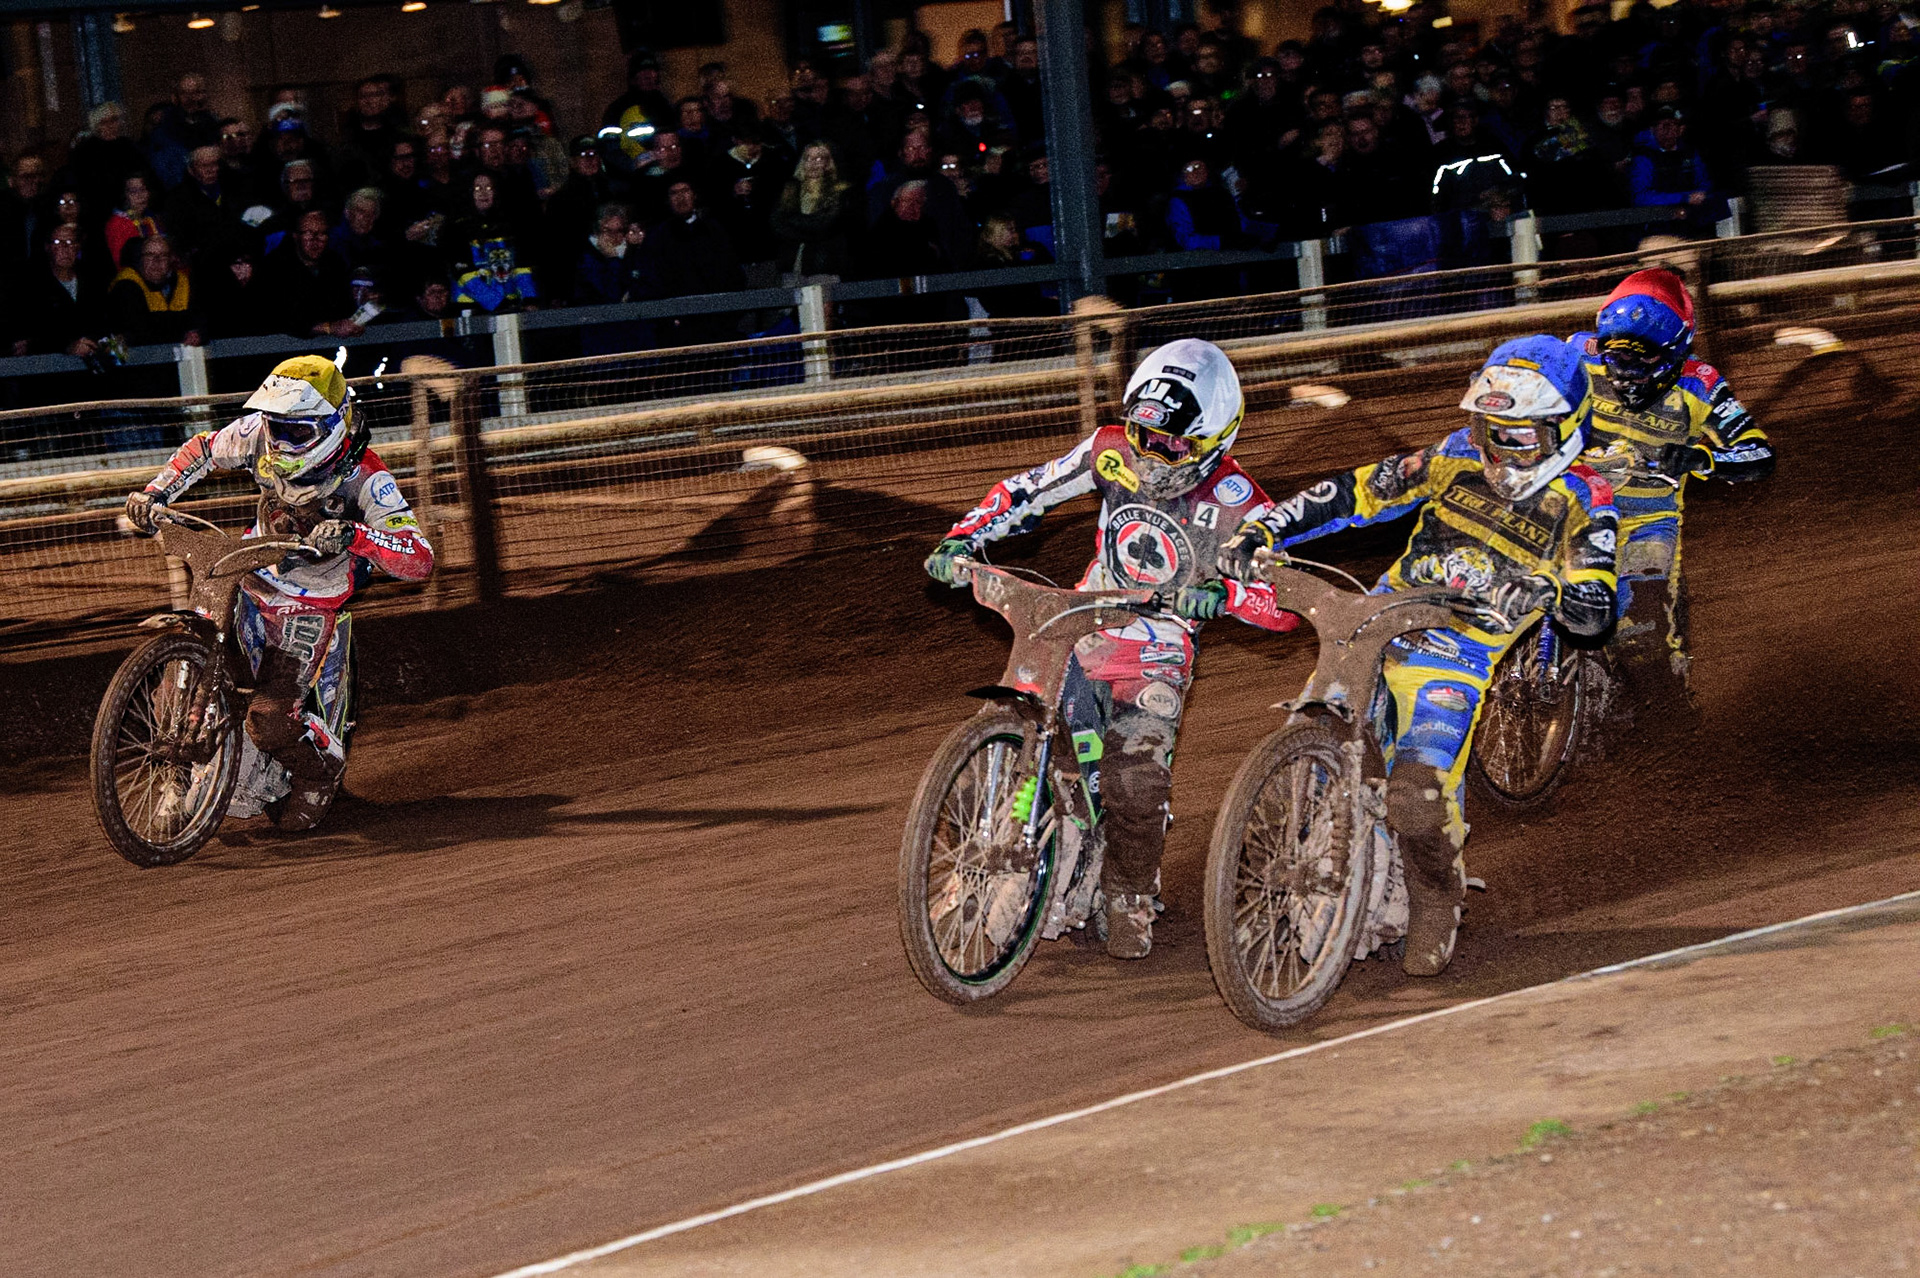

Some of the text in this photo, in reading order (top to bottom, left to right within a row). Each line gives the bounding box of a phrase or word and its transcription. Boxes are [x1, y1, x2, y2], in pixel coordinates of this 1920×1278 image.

[1592, 399, 1621, 414] TRU
[1664, 391, 1683, 411] 4
[1222, 478, 1245, 498] ATPI
[1202, 507, 1214, 528] 4
[1453, 490, 1550, 544] TRU PLANT
[1112, 509, 1190, 563] BELLE VUE ACES
